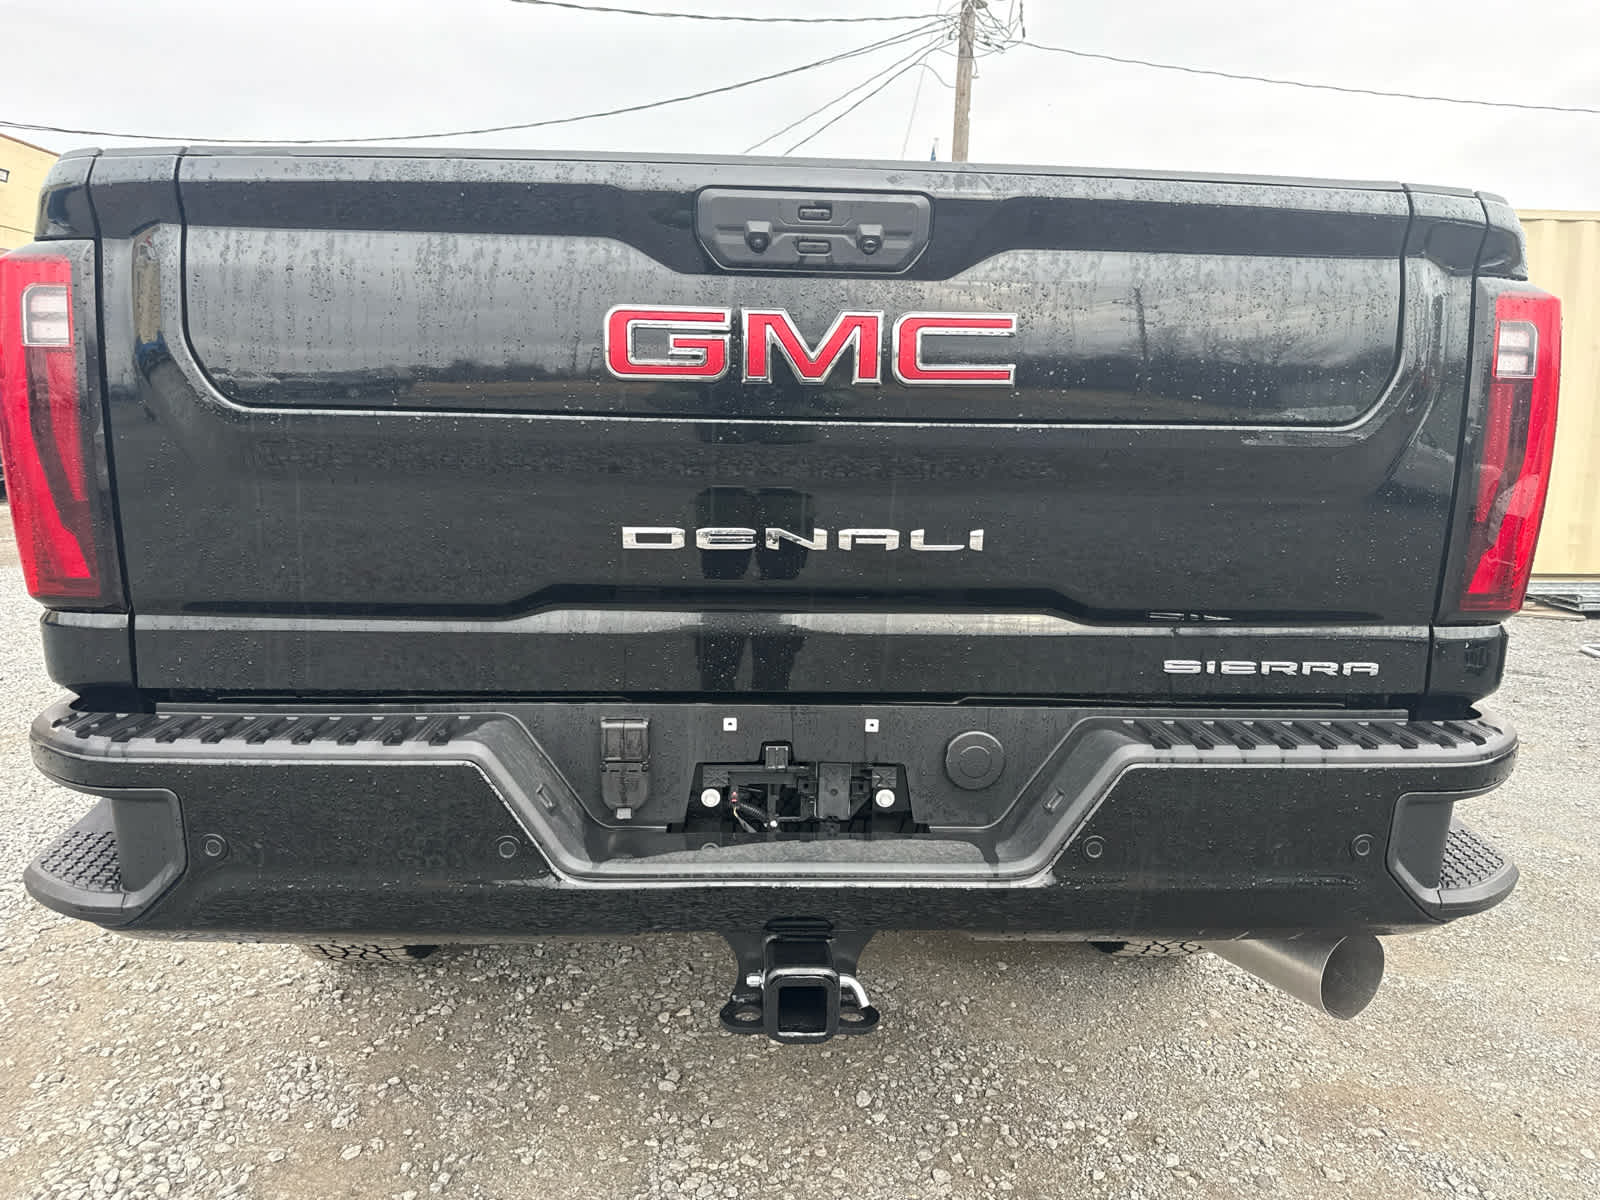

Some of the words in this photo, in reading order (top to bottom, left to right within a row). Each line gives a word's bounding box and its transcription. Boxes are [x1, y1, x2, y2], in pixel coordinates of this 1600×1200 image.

[603, 304, 1018, 387] GMC
[622, 526, 984, 551] DENALI
[1163, 660, 1379, 677] SIERRA
